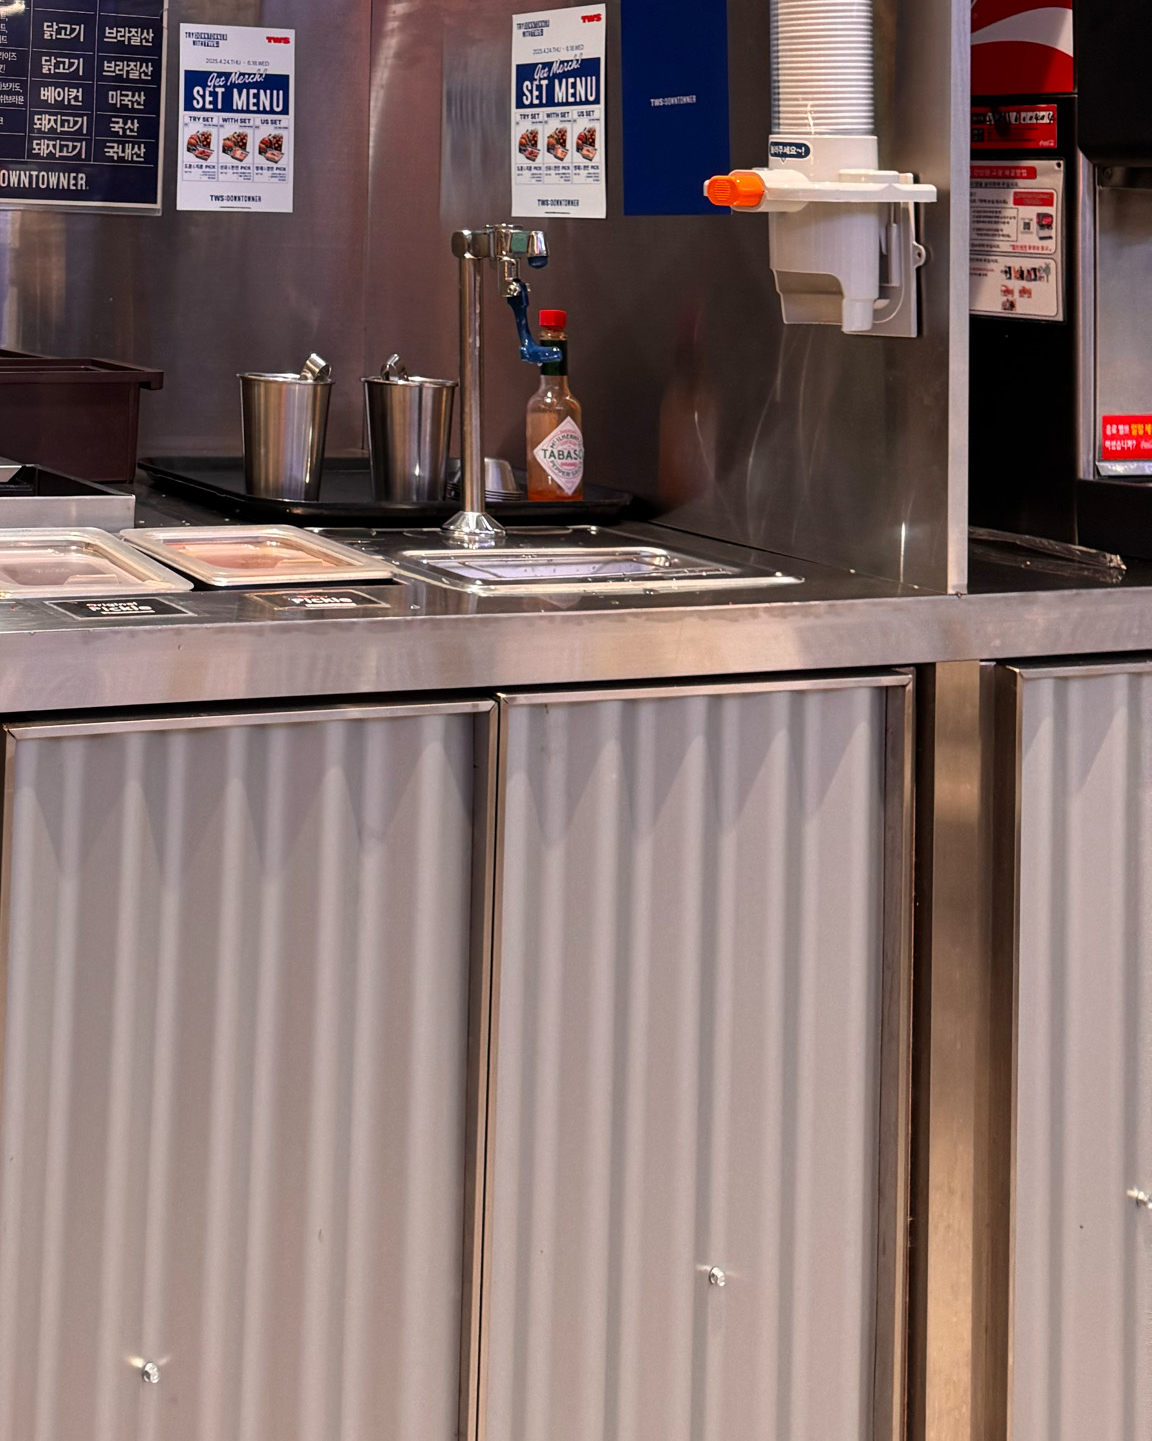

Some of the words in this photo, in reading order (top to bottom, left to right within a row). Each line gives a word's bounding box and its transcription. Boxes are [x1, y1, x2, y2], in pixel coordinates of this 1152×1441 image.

[43, 22, 84, 42] 닭고기
[103, 26, 154, 46] 브라질산
[41, 56, 83, 76] 닭고기
[102, 60, 153, 79] 브라질산
[207, 73, 226, 91] Get
[227, 68, 268, 86] Merch!
[40, 86, 83, 105] 베이컨
[108, 90, 145, 109] 미국산
[193, 86, 225, 109] SET
[233, 88, 283, 112] MENU
[523, 79, 548, 105] SET
[554, 76, 596, 103] MENU
[33, 114, 87, 134] 돼지고기
[109, 117, 139, 136] 국산
[32, 139, 86, 159] 돼지고기
[104, 143, 146, 161] 국내산
